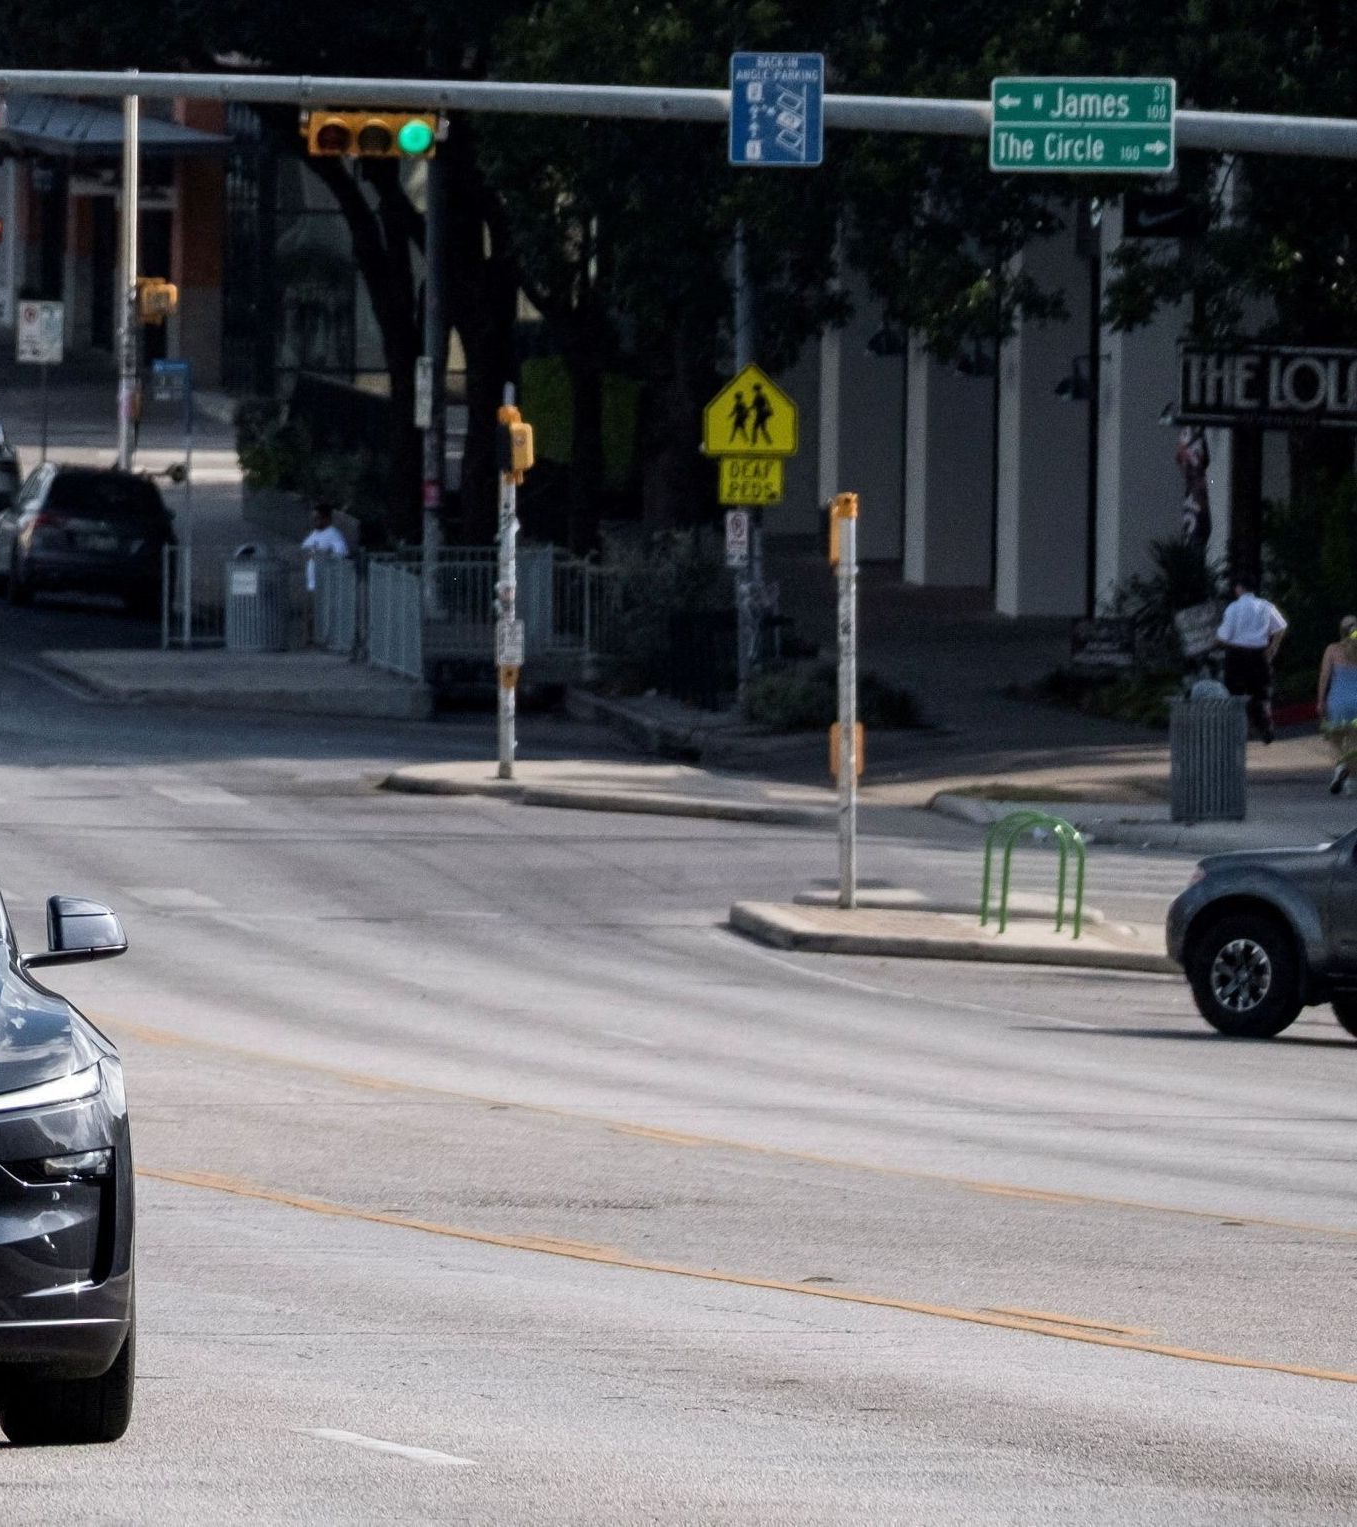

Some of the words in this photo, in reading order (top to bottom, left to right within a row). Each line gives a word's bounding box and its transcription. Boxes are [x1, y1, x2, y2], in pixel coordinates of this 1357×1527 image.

[736, 69, 770, 80] ANGLE
[774, 69, 819, 81] PARKING
[1033, 93, 1043, 110] W
[1049, 86, 1130, 118] James
[1153, 85, 1166, 103] ST
[1146, 104, 1167, 119] 100
[998, 132, 1034, 161] The
[1044, 132, 1105, 161] Circle
[1120, 145, 1140, 161] 100
[1185, 355, 1261, 409] THE
[730, 461, 773, 479] DEAF
[728, 482, 774, 499] PEDS
